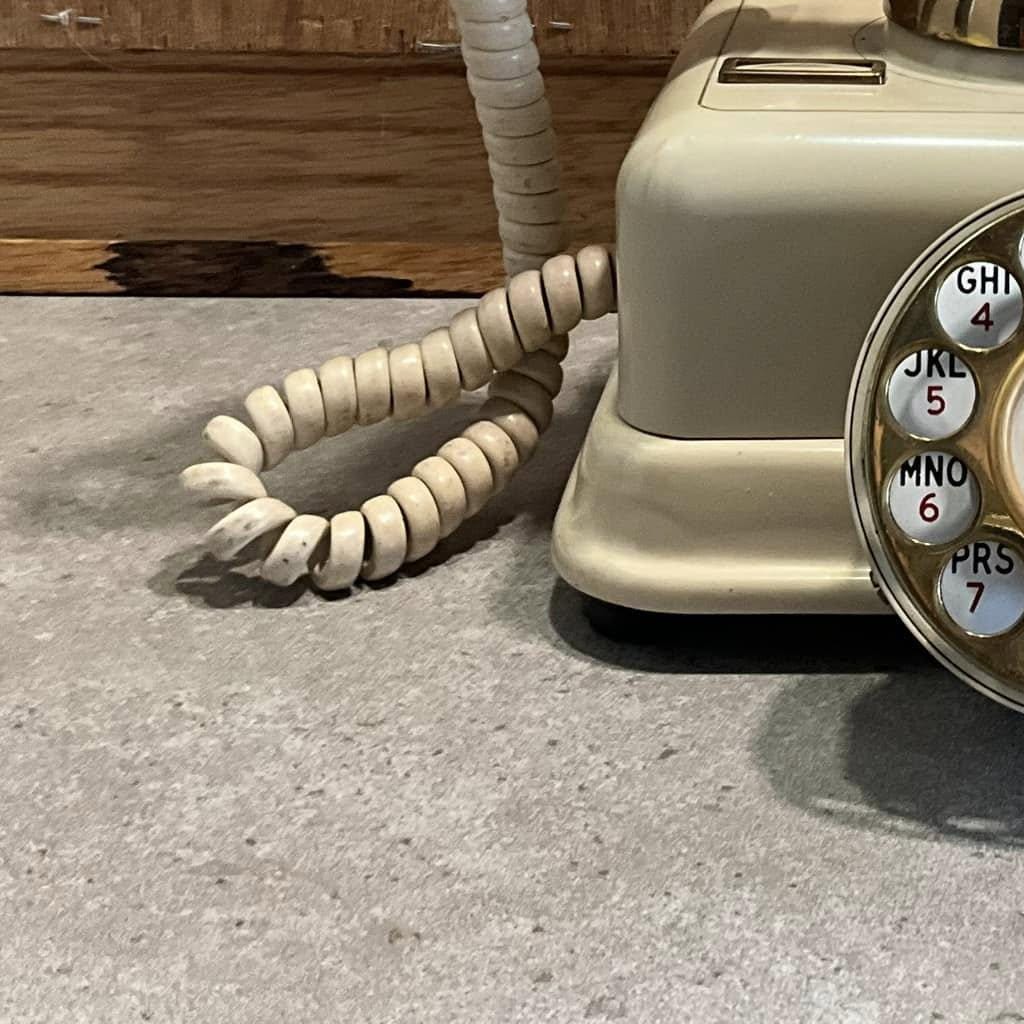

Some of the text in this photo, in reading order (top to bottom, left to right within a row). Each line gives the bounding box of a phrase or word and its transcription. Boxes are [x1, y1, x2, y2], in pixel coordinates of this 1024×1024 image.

[957, 266, 1010, 294] GHI
[970, 302, 994, 332] 4
[904, 349, 966, 378] JKL
[927, 386, 945, 415] 5
[899, 456, 967, 487] MNO
[919, 493, 939, 522] 6
[951, 542, 1014, 574] PRS
[966, 582, 985, 613] 7
